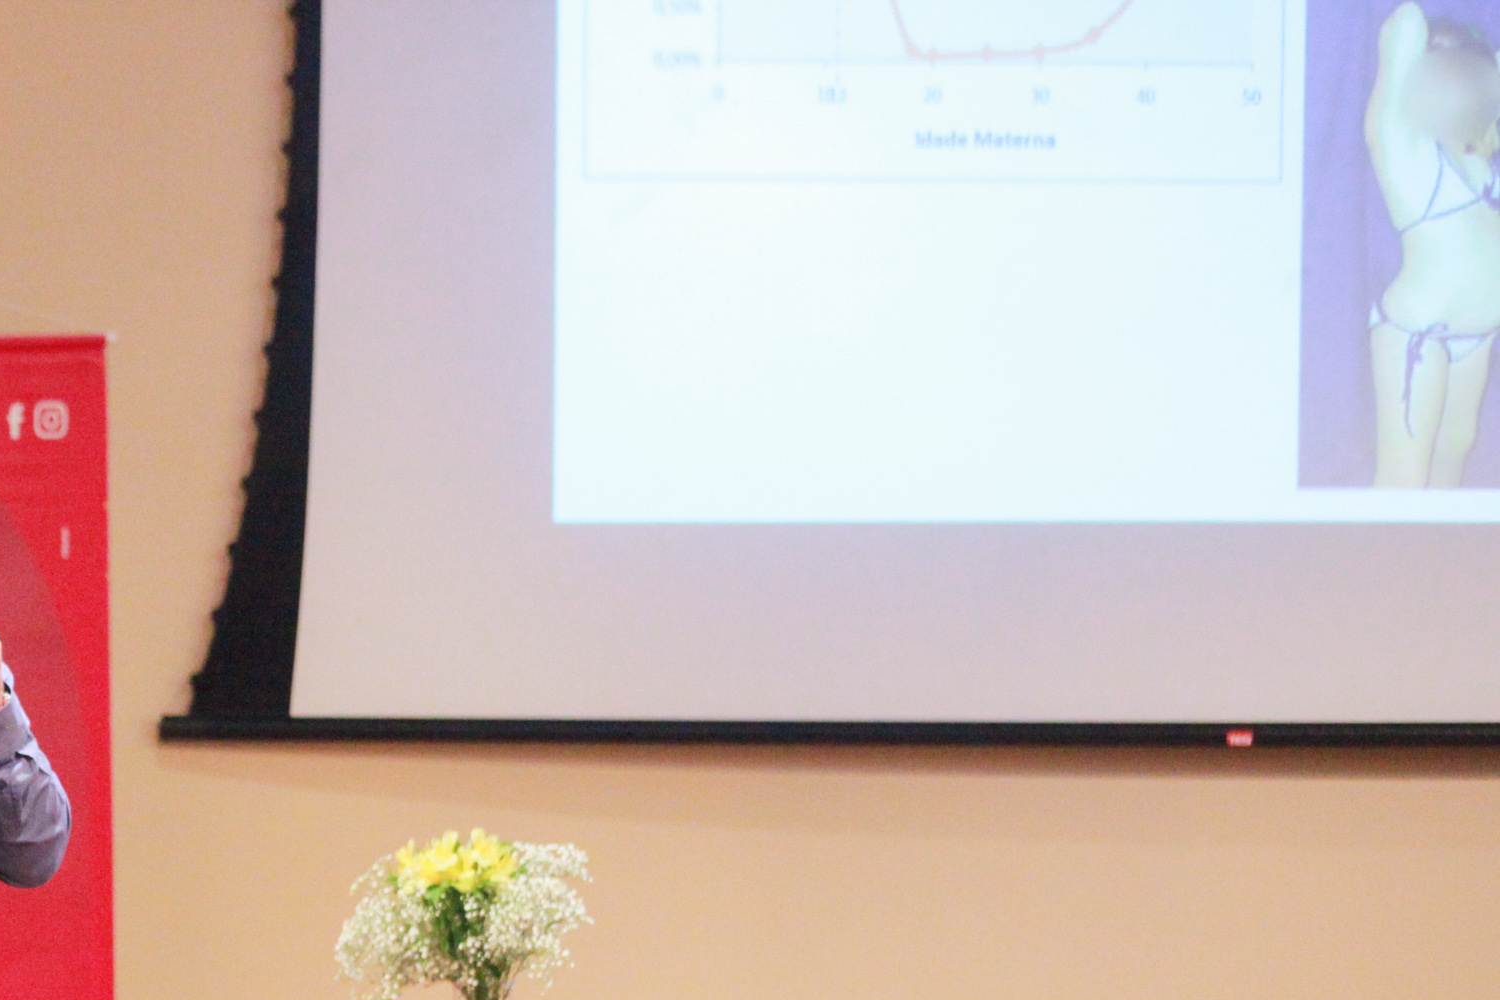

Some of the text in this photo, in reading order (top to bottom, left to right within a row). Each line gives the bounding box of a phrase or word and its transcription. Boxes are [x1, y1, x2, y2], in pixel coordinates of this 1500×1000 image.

[1242, 88, 1262, 106] 50
[915, 129, 1057, 151] Idade Materna
